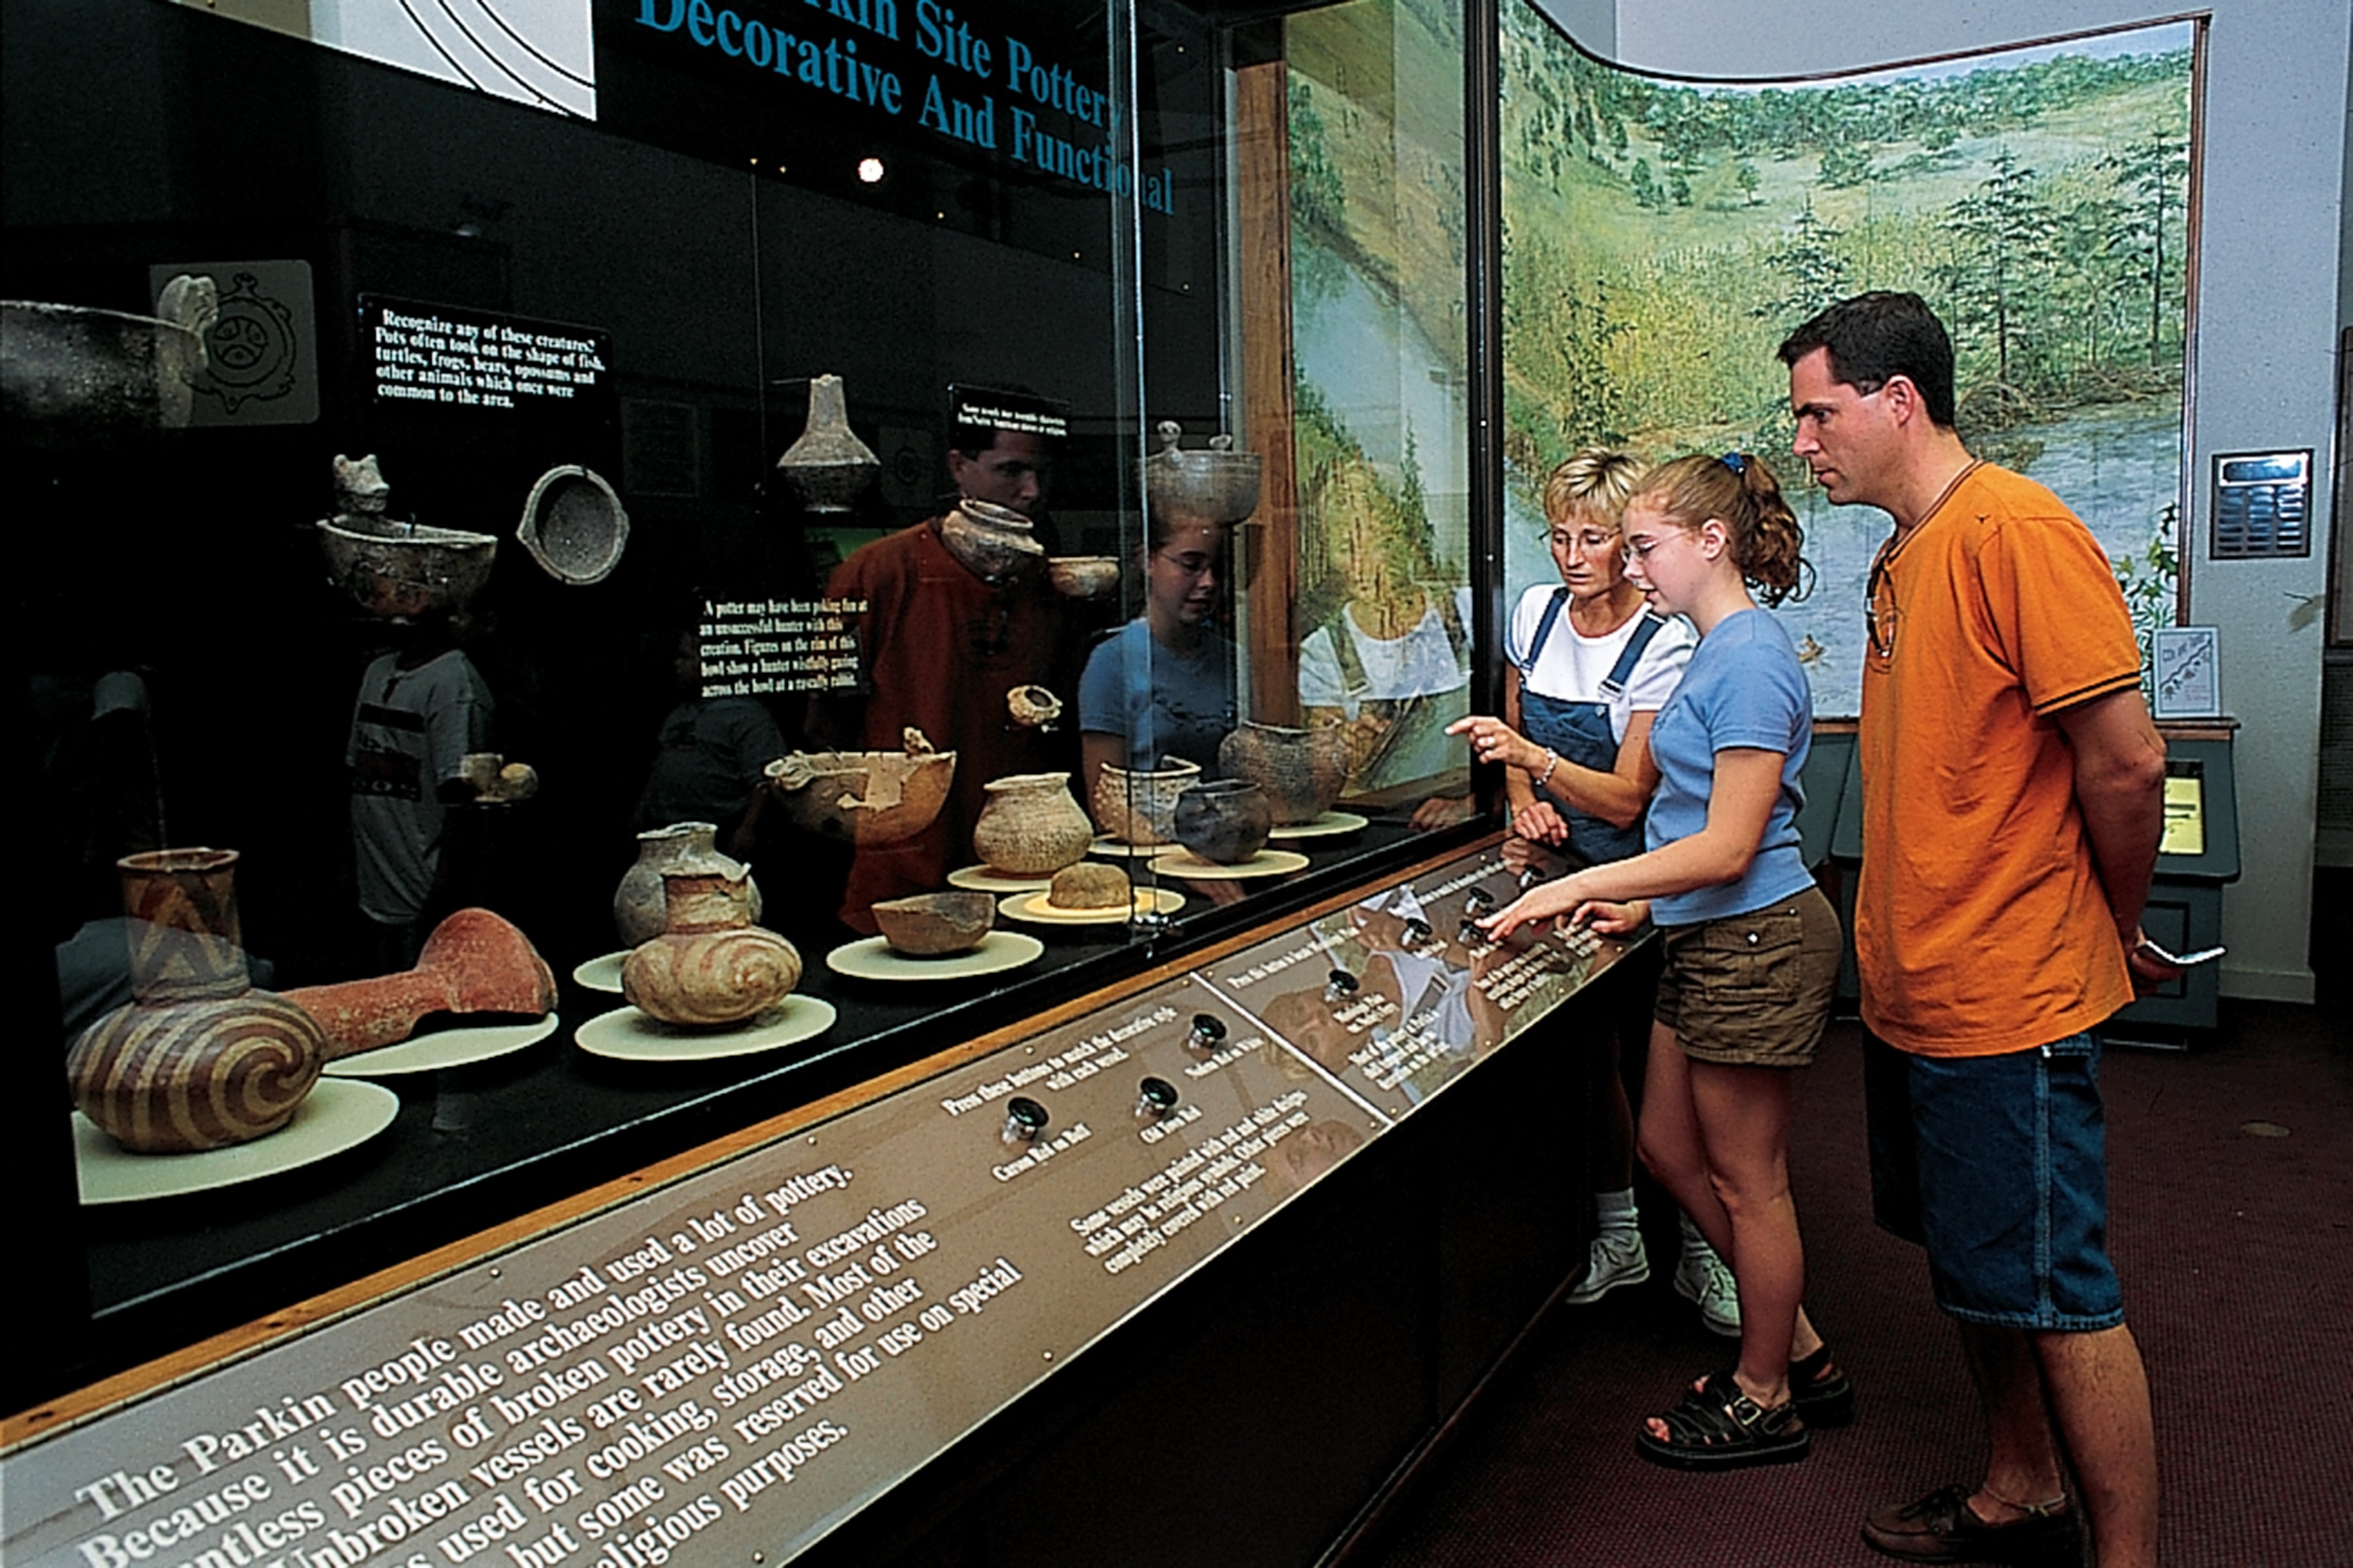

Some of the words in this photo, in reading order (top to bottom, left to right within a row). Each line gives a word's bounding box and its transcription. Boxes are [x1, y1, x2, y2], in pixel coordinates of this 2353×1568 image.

[635, 0, 902, 114] Decorative
[919, 74, 997, 149] And
[916, 0, 991, 78] Site
[375, 327, 407, 344] Pots
[409, 332, 446, 350] often
[449, 338, 479, 355] took
[481, 342, 499, 358] on
[501, 344, 522, 359] the
[525, 347, 560, 366] shape
[562, 352, 576, 367] of
[375, 347, 428, 367] turtles,
[432, 351, 471, 371] frogs,
[473, 356, 511, 376] bears,
[573, 371, 596, 384] and
[376, 365, 414, 382] other
[418, 370, 473, 388] animals
[477, 375, 513, 392] which
[516, 380, 545, 396] once
[547, 384, 575, 399] were
[382, 309, 452, 334] Recognize
[456, 323, 479, 340] any
[483, 324, 498, 341] of
[501, 327, 533, 345] these
[377, 383, 436, 401] common
[439, 388, 454, 403] to
[457, 388, 479, 405] the
[482, 392, 514, 408] area.
[75, 1464, 178, 1522] The
[182, 1393, 337, 1475] Parkin
[341, 1338, 456, 1410] people
[459, 1299, 546, 1350] made
[547, 1266, 607, 1310] and
[605, 1237, 673, 1282] used
[671, 1231, 697, 1254] a
[687, 1210, 737, 1243] lot
[734, 1195, 768, 1226] of
[765, 1164, 853, 1216] pottery.
[78, 1474, 271, 1568] Because
[273, 1445, 320, 1485] it
[320, 1427, 367, 1462] is
[371, 1363, 503, 1438] durable
[506, 1265, 708, 1374] archaeologists
[705, 1222, 800, 1277] uncover
[331, 1439, 449, 1519] pieces
[452, 1406, 495, 1449] of
[488, 1358, 609, 1426] broken
[607, 1305, 711, 1375] pottery
[703, 1290, 747, 1318] in
[740, 1256, 808, 1301] their
[805, 1197, 927, 1269] excavations
[470, 1416, 586, 1488] vessels
[586, 1386, 643, 1429] are
[641, 1339, 732, 1399] rarely
[724, 1295, 812, 1352] found.
[800, 1259, 873, 1309] Most
[869, 1244, 902, 1276] of
[892, 1229, 938, 1261] the
[438, 1493, 528, 1563] used
[522, 1468, 584, 1513] for
[587, 1399, 719, 1478] cooking,
[712, 1341, 822, 1408] storage,
[814, 1306, 865, 1350] and
[860, 1277, 924, 1323] other
[504, 1522, 580, 1568] but
[578, 1476, 666, 1540] some
[662, 1435, 730, 1484] was
[733, 1363, 845, 1444] reserved
[834, 1346, 883, 1382] for
[877, 1321, 924, 1357] use
[918, 1303, 956, 1333] on
[948, 1257, 1024, 1314] special
[720, 1418, 849, 1512] purposes.
